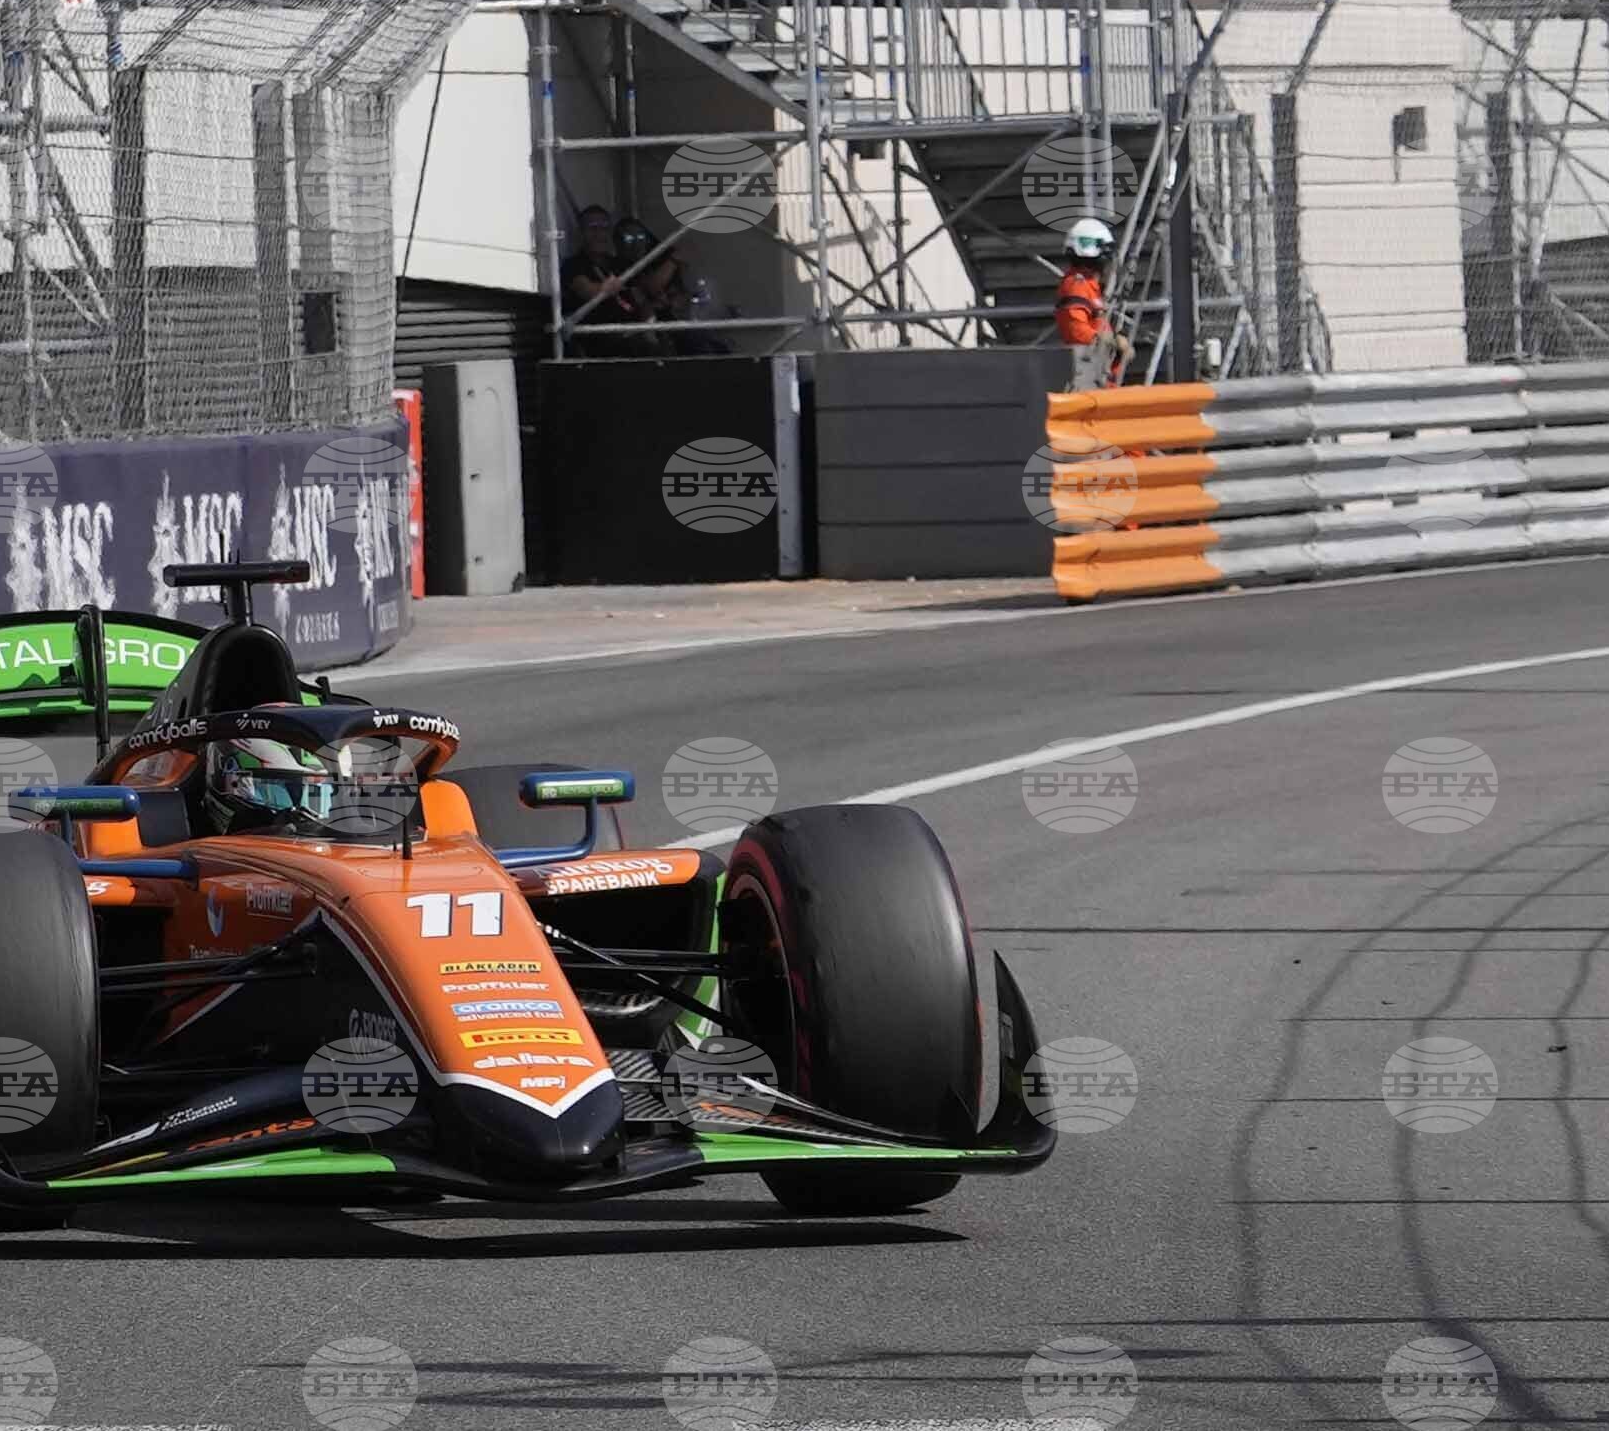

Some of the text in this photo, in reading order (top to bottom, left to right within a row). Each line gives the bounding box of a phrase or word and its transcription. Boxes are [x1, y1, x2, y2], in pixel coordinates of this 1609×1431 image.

[547, 871, 660, 896] SPAREBANK
[406, 891, 502, 938] 11
[460, 1000, 551, 1013] aramco
[473, 1052, 595, 1070] dallara
